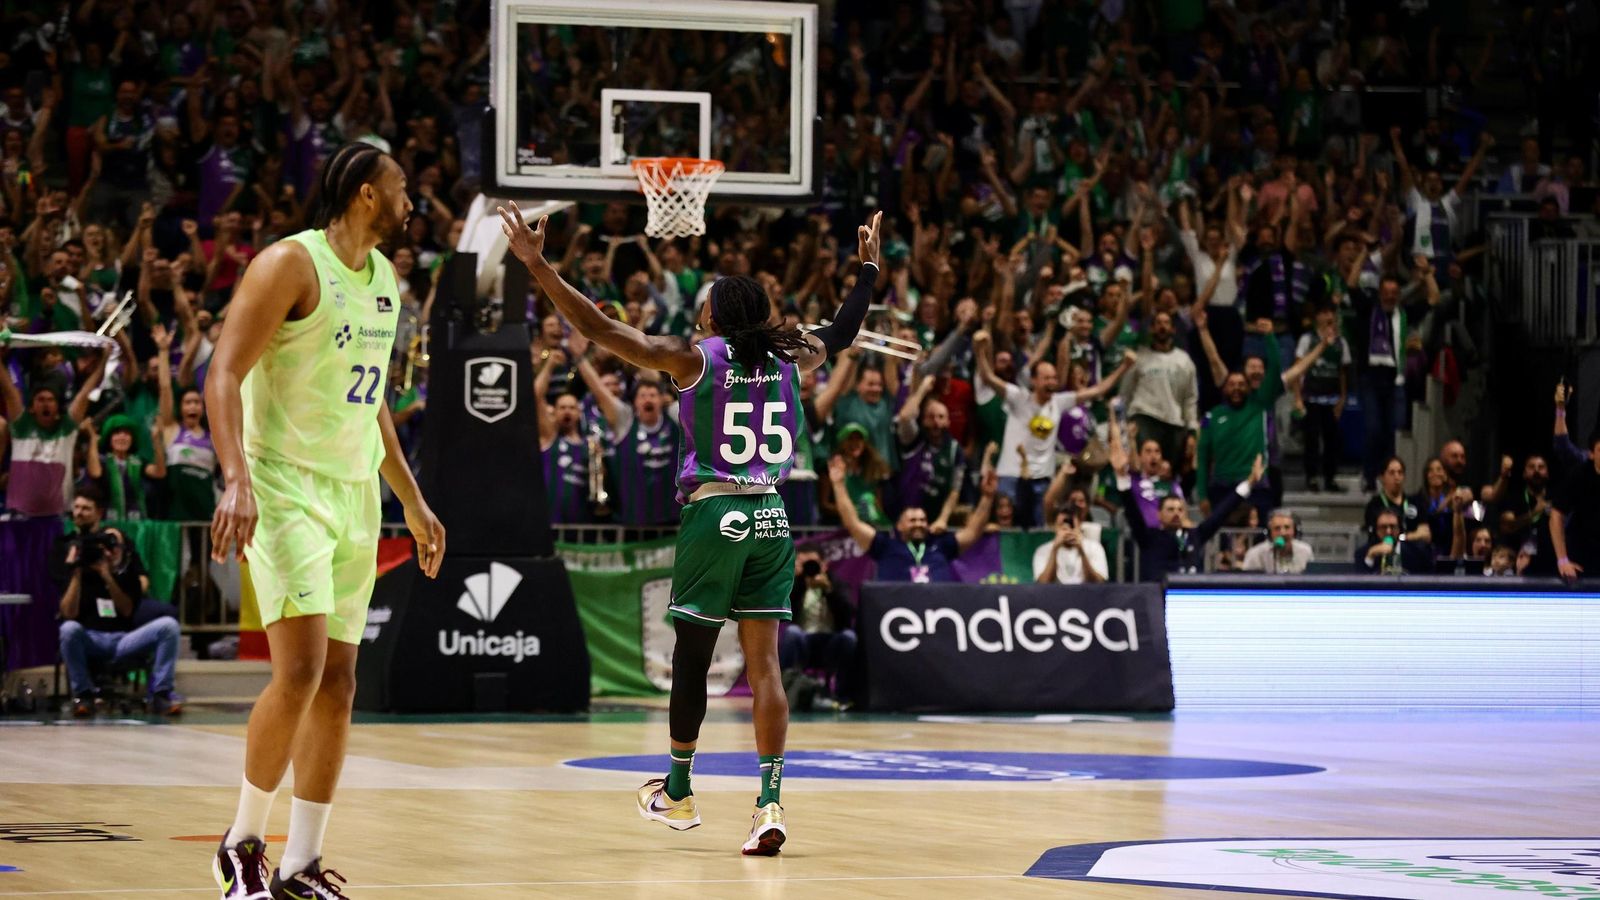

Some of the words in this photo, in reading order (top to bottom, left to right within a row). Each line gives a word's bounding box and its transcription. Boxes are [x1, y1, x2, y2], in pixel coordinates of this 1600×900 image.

[347, 365, 380, 404] 22
[720, 402, 793, 465] 55
[755, 520, 775, 530] DEL
[880, 595, 1139, 652] endesa
[439, 629, 540, 663] Unicaja
